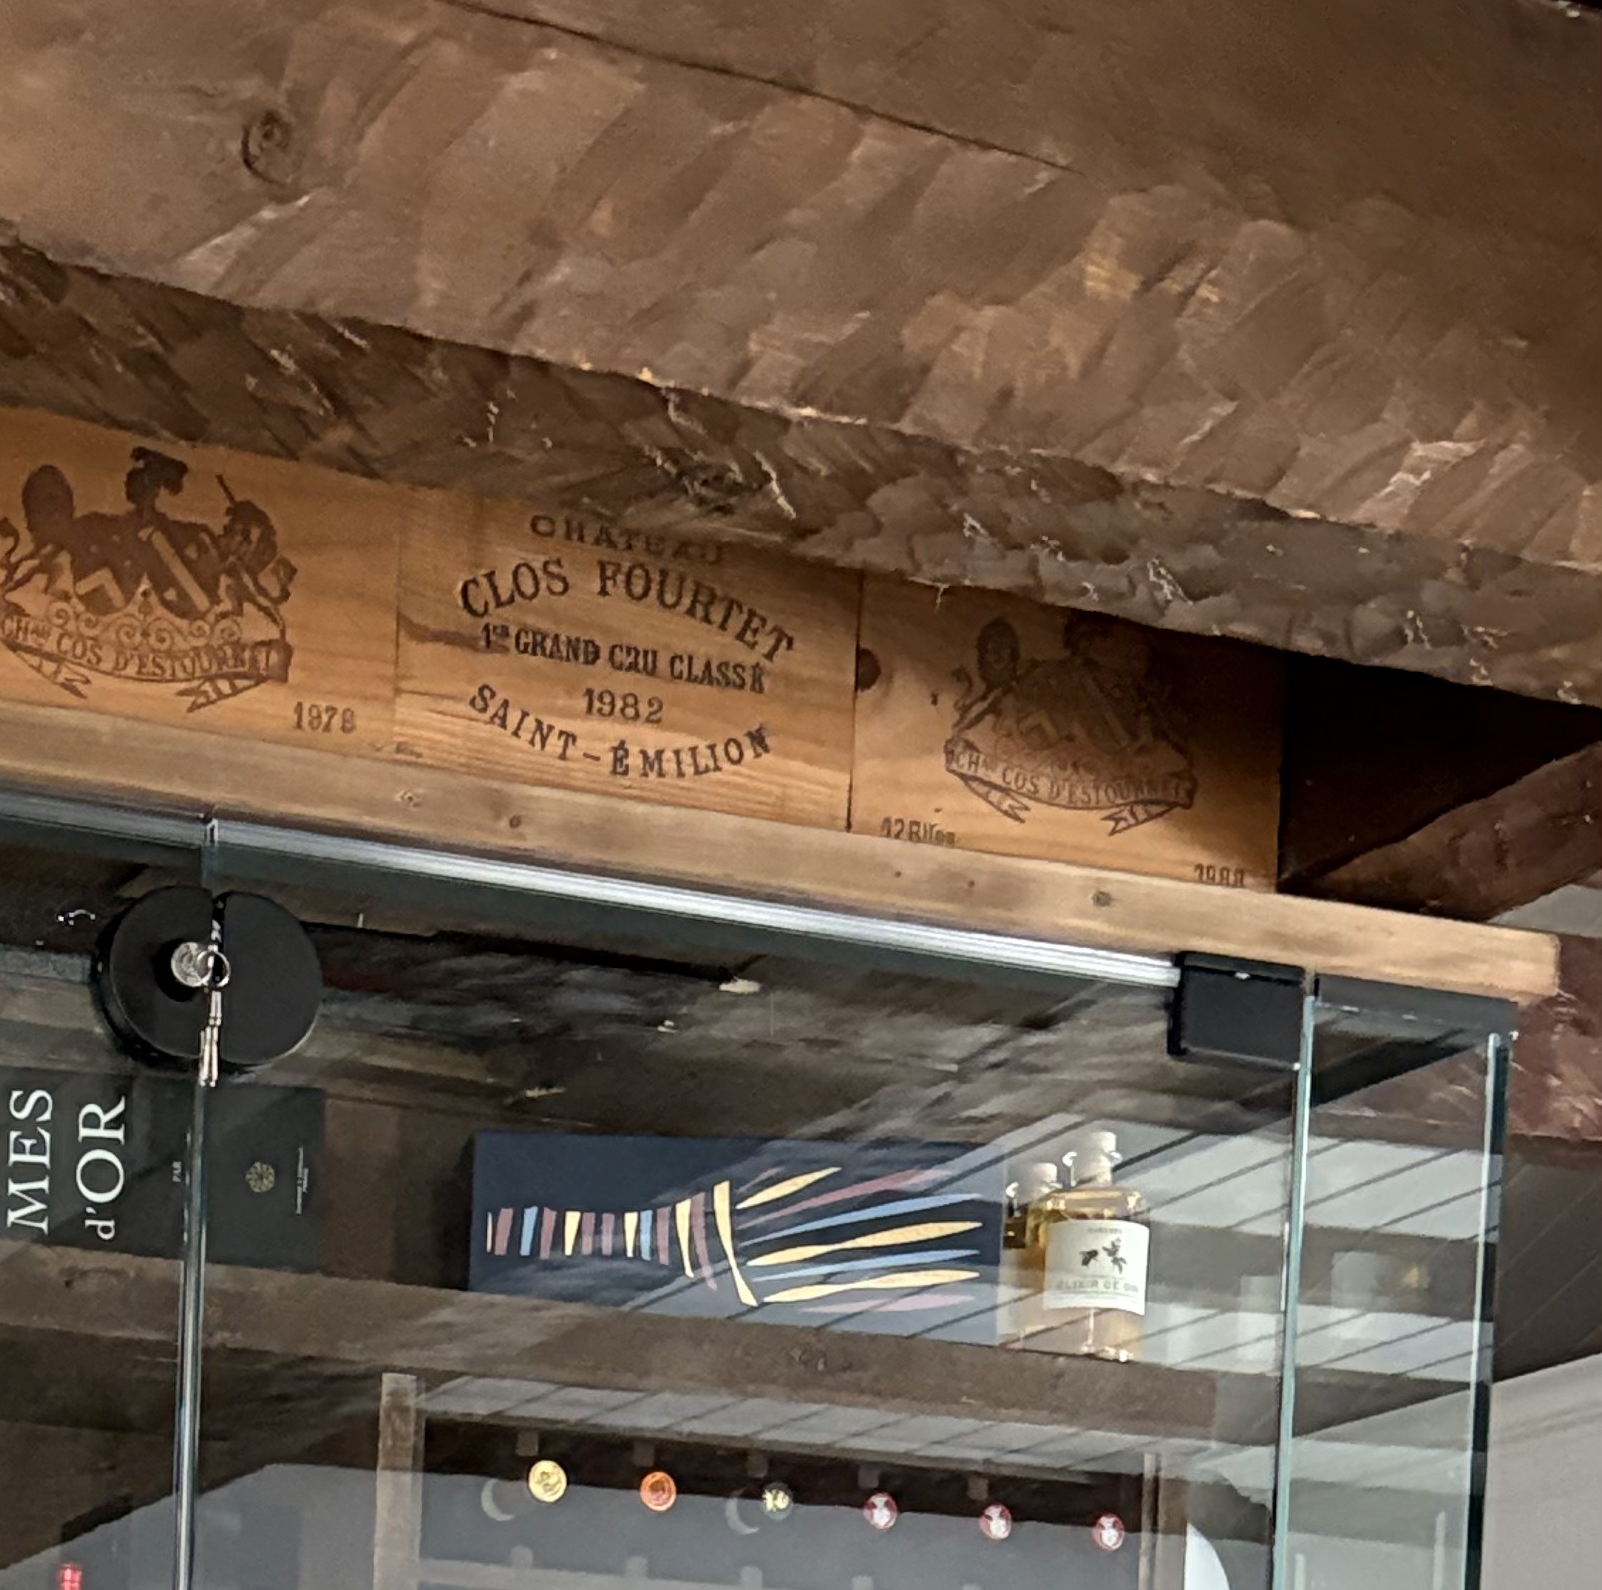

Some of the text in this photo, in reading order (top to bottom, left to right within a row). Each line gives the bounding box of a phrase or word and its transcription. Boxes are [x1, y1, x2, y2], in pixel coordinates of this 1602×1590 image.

[458, 556, 794, 666] CLOS FOURTET
[55, 629, 104, 667] COS
[514, 627, 600, 667] GRAND
[607, 642, 658, 678] CRU
[583, 686, 665, 726] 1982
[1001, 767, 1040, 795] COS
[6, 1088, 55, 1236] MES
[75, 1095, 127, 1241] d'OR
